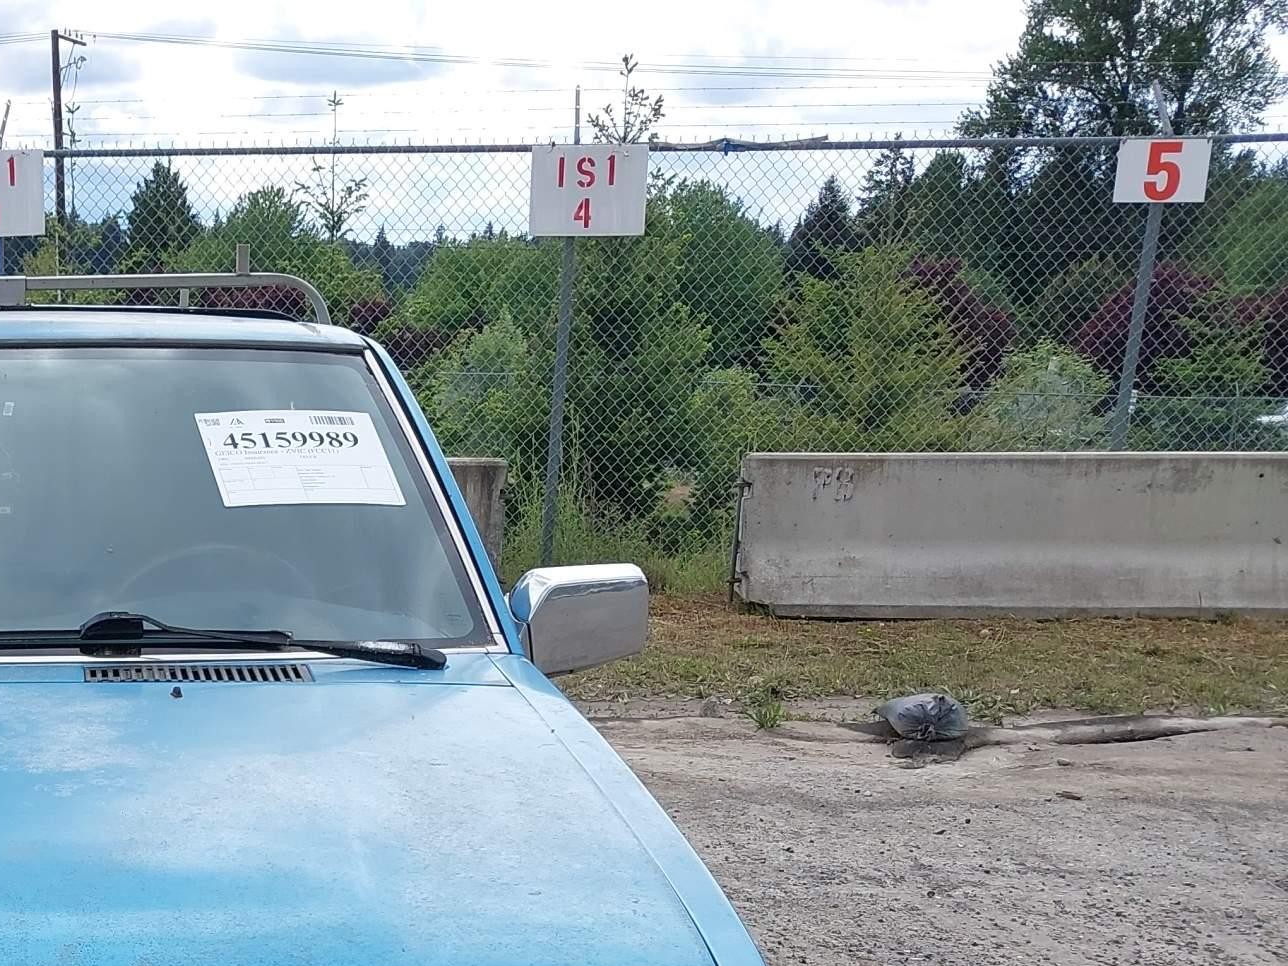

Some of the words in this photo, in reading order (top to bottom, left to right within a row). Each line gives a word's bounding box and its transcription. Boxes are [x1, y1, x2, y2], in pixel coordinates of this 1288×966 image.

[1143, 141, 1183, 201] 5
[573, 197, 591, 229] 4
[223, 431, 359, 449] 45159989
